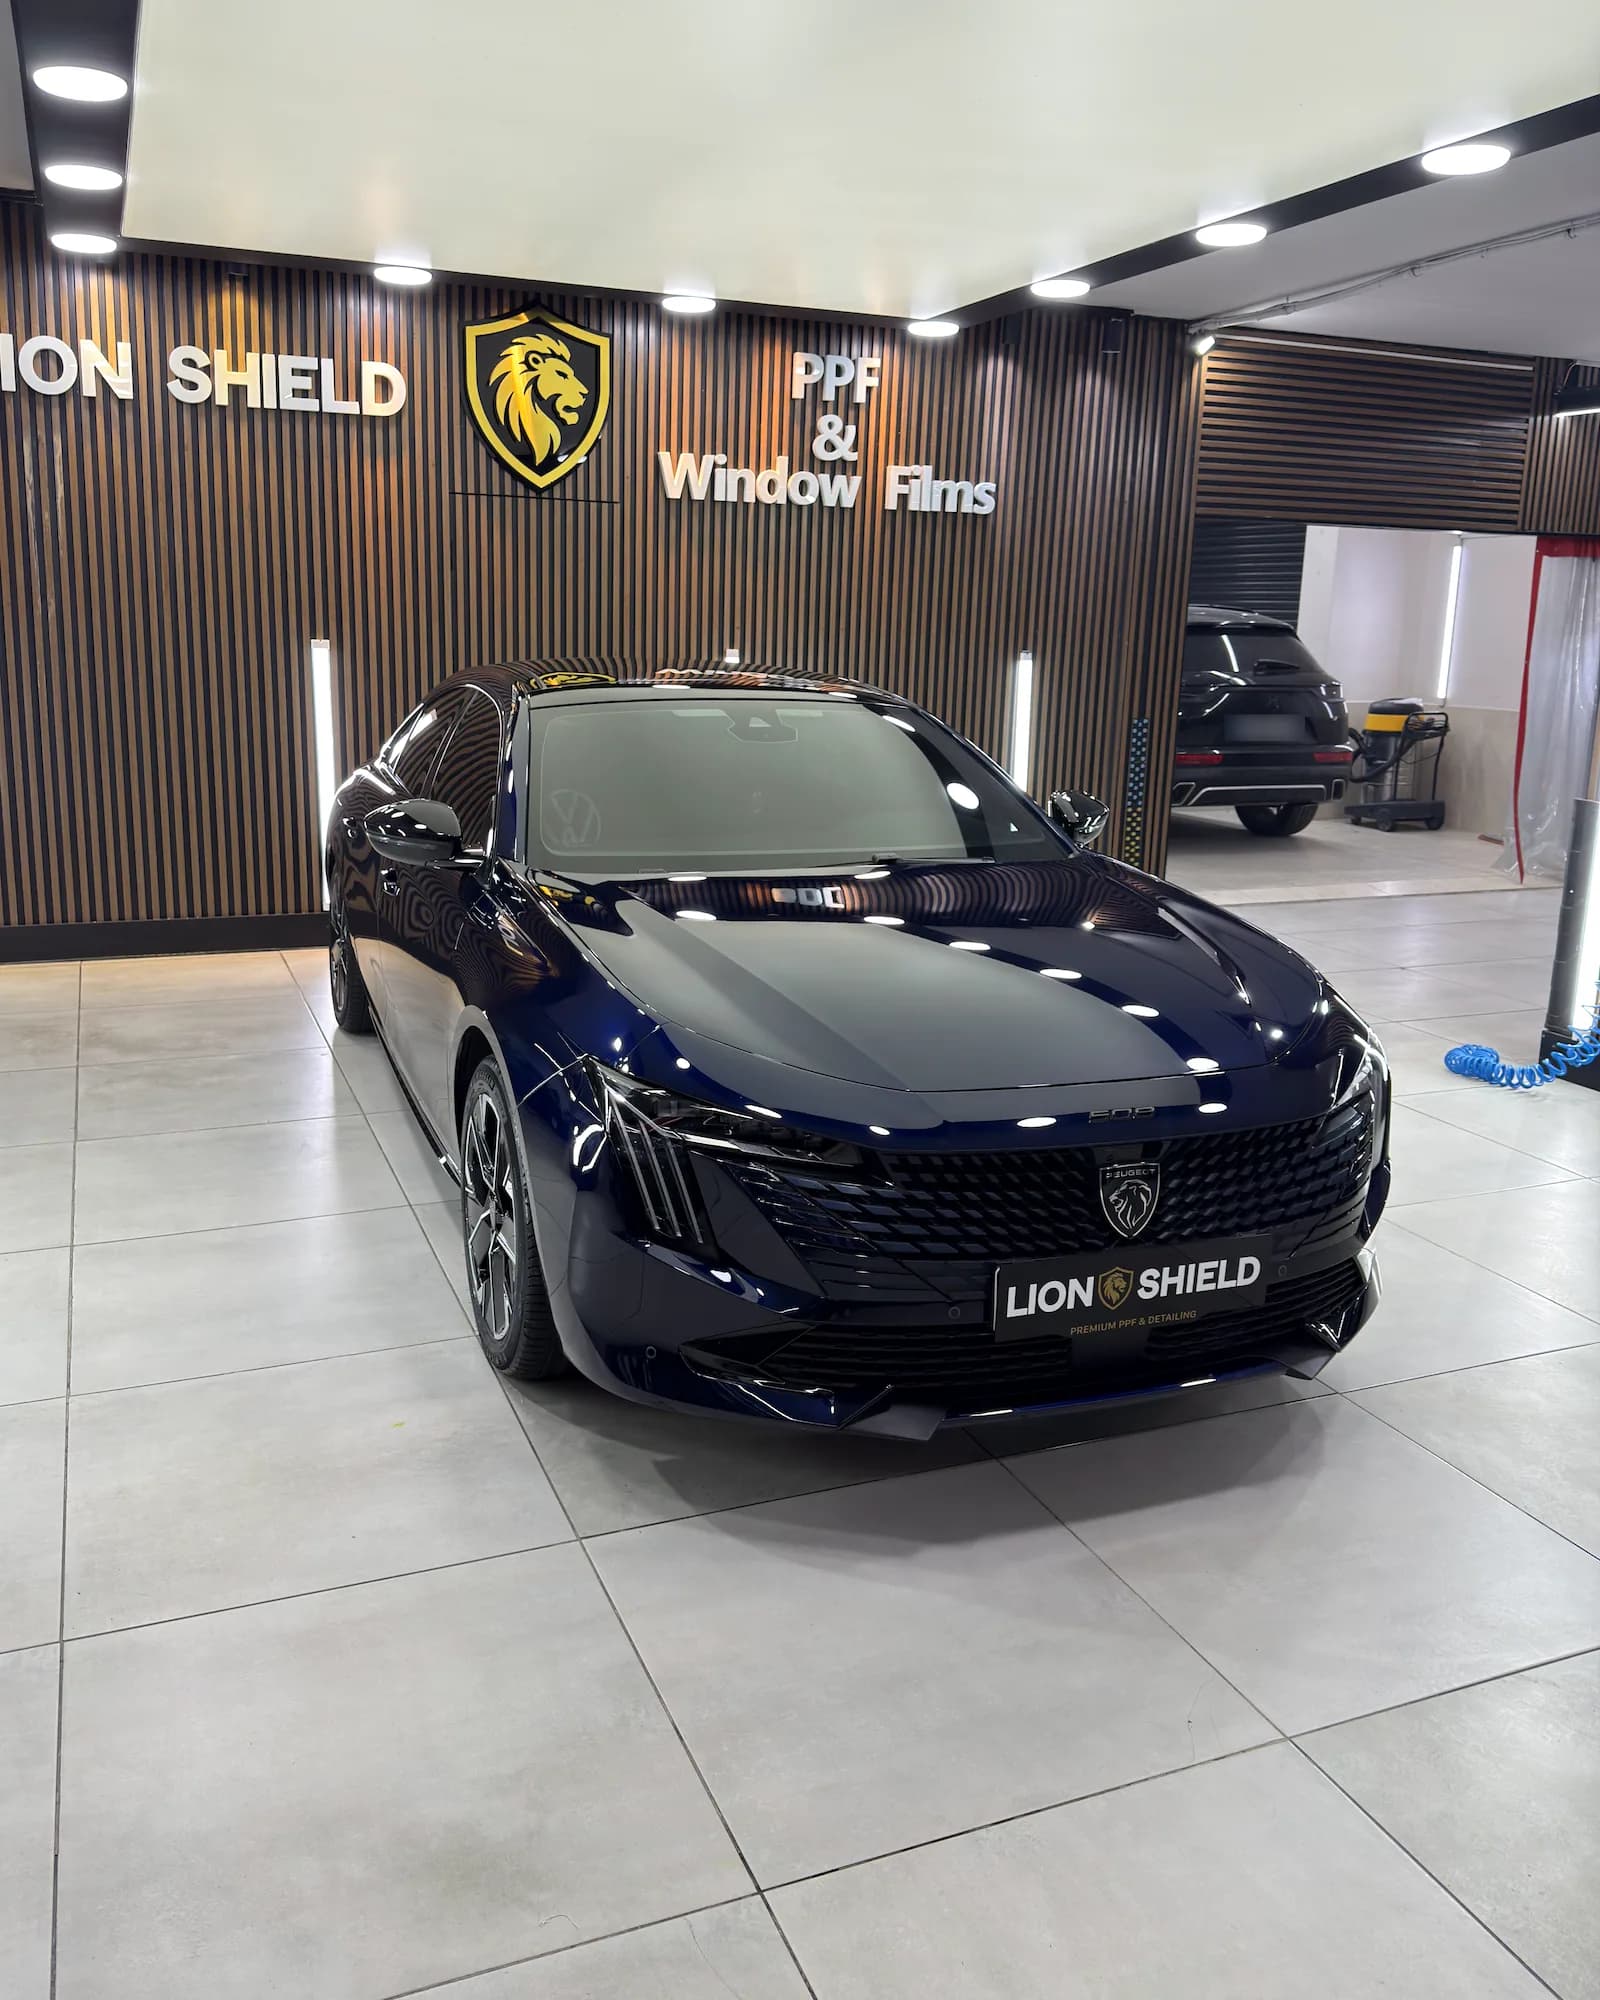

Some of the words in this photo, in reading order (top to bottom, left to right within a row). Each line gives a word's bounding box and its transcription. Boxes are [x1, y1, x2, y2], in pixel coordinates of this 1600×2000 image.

[167, 345, 407, 417] SHIELD
[791, 351, 881, 404] PPF
[812, 414, 858, 462] &
[657, 451, 862, 509] Window
[884, 465, 997, 515] Films
[1105, 1168, 1156, 1179] PEUGEOT
[1006, 1276, 1095, 1319] LION
[1136, 1256, 1262, 1298] SHIELD
[1070, 1321, 1116, 1335] PREMIUM
[1118, 1318, 1138, 1329] PPF
[1138, 1317, 1147, 1326] &
[1147, 1310, 1197, 1325] DETAILING
